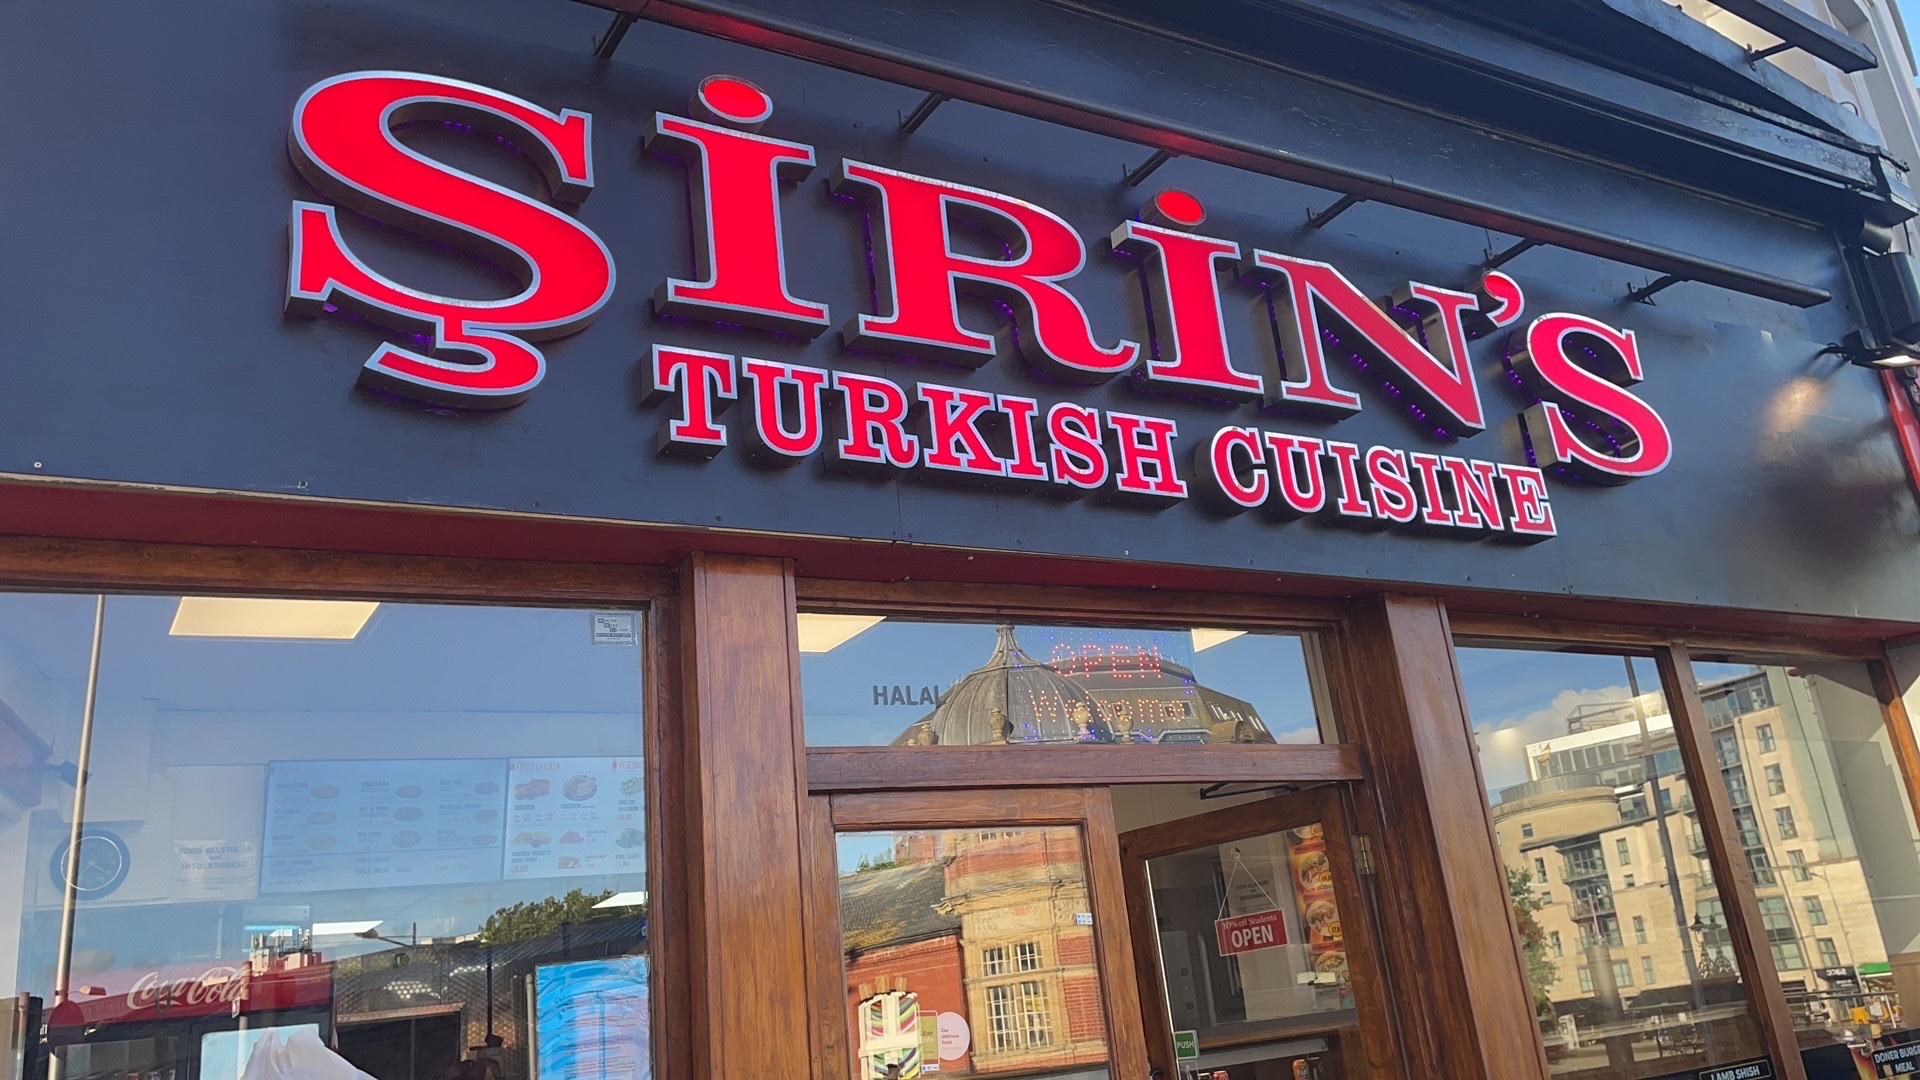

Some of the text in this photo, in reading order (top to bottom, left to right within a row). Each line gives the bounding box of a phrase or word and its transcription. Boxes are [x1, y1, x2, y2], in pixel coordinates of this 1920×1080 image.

[652, 343, 1558, 537] TURKISH CUISINE
[1052, 644, 1161, 678] OPEN
[873, 684, 946, 706] HALAL
[1028, 690, 1185, 722] Welcome
[1222, 915, 1277, 930] 10% off Students
[1231, 924, 1274, 949] OPEN
[1177, 1040, 1195, 1050] PUSH
[1874, 1050, 1900, 1064] DONER
[1735, 1065, 1761, 1080] SHISH
[1895, 1061, 1916, 1074] MEAL
